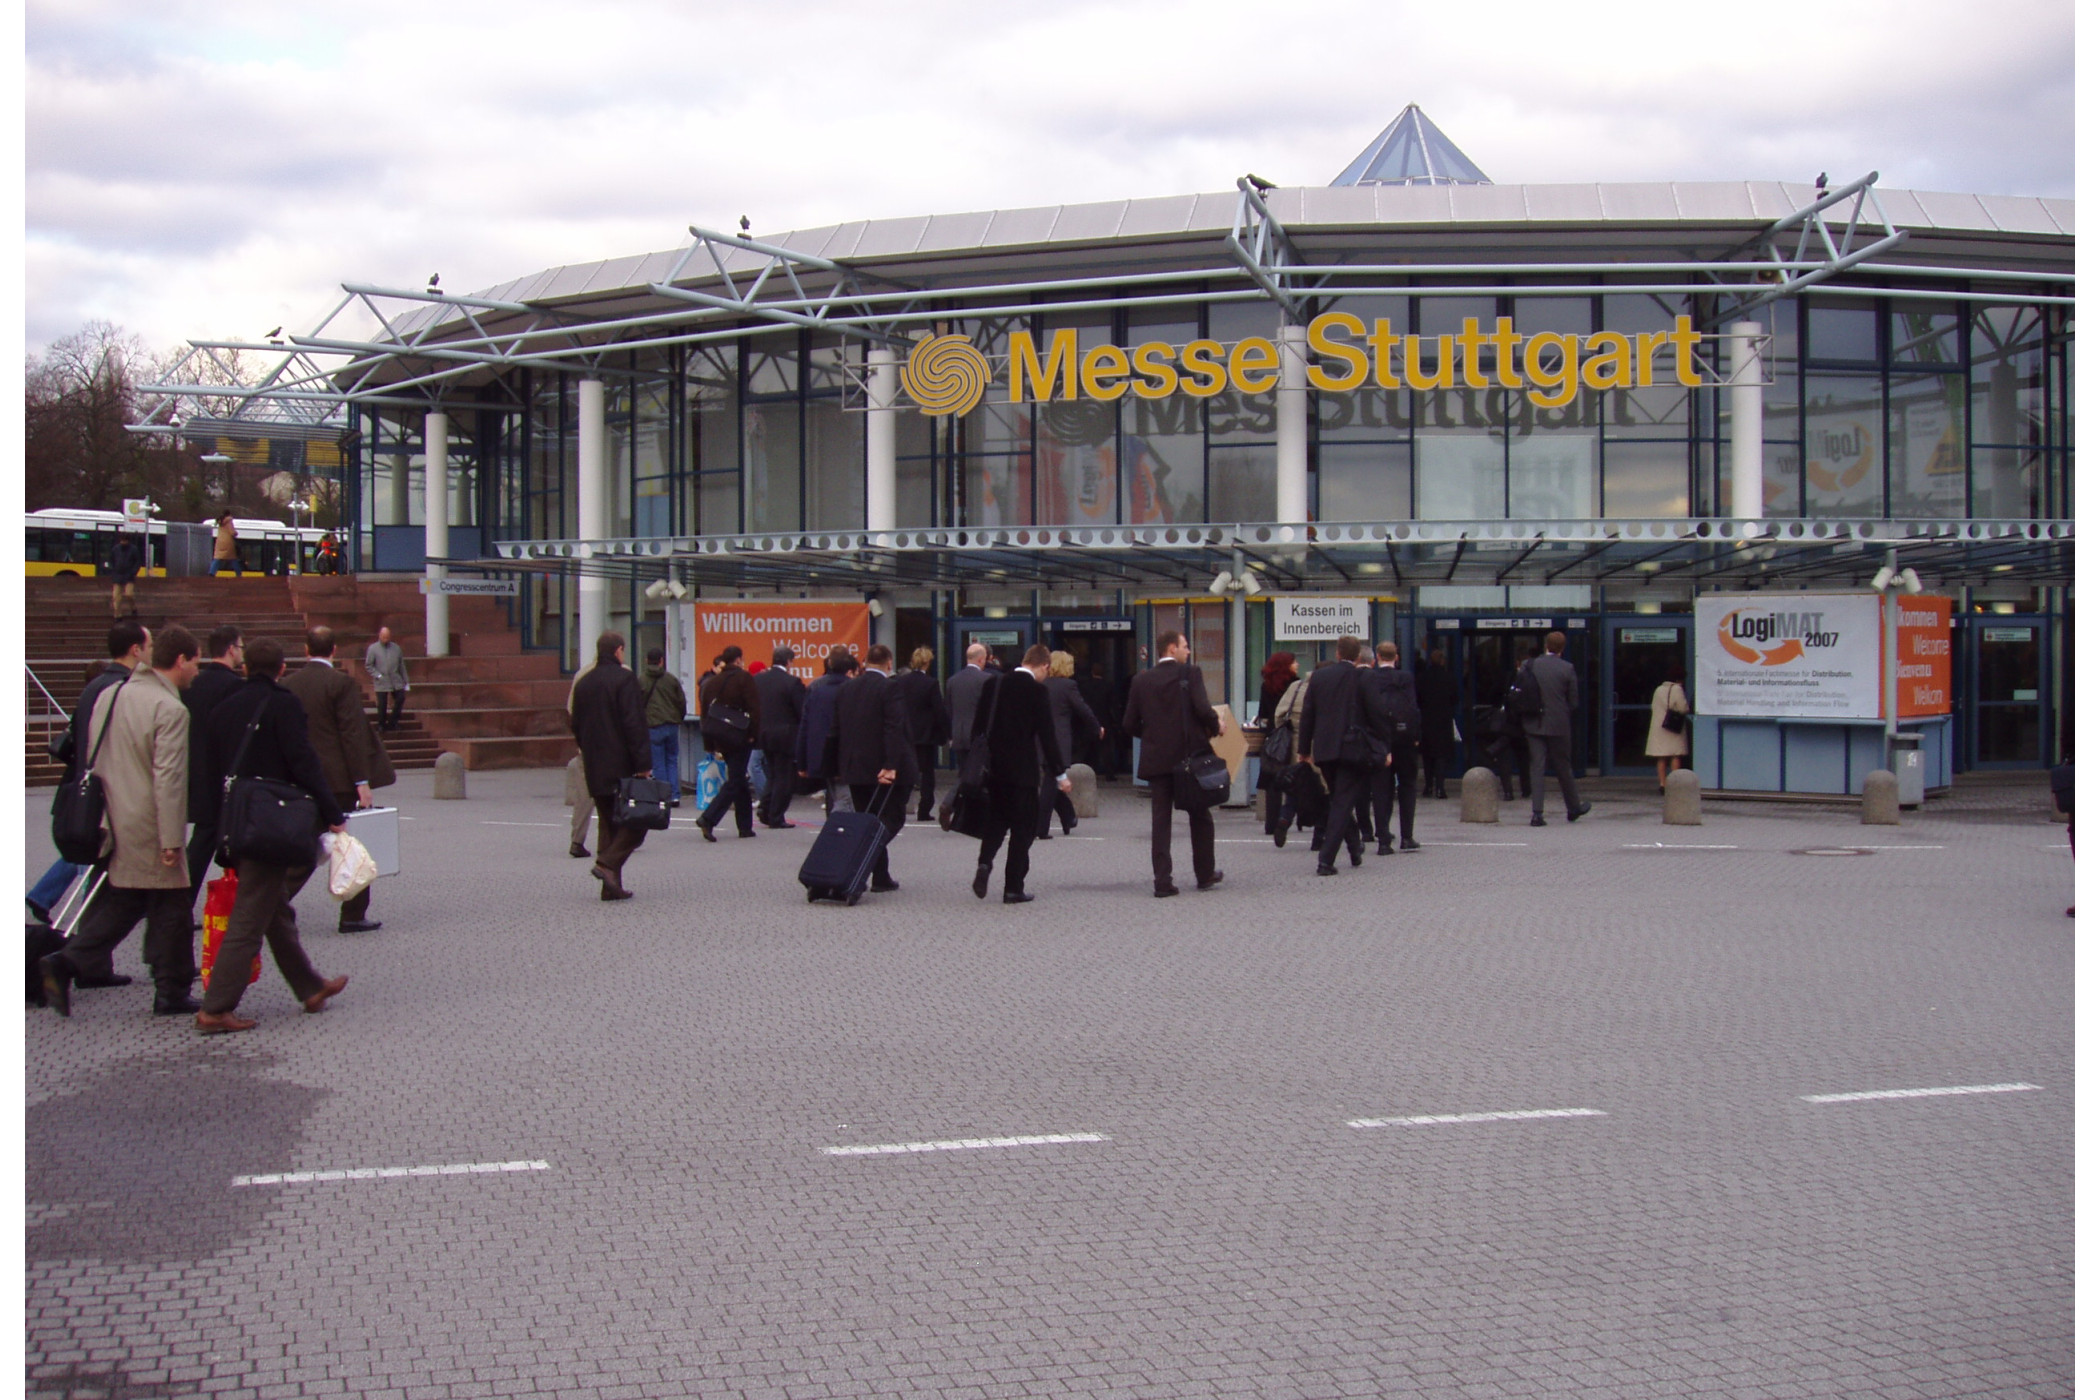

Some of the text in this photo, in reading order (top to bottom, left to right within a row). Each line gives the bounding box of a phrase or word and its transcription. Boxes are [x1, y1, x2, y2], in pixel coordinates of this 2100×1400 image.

[1008, 311, 1702, 408] Messe Stuttgart
[439, 581, 515, 592] Congresscentrum A
[1291, 604, 1353, 616] Kassen im
[701, 612, 833, 633] Willkommen
[1283, 622, 1361, 634] Innenbereich
[1732, 612, 1824, 642] LogiMAT
[1805, 632, 1839, 647] 2007
